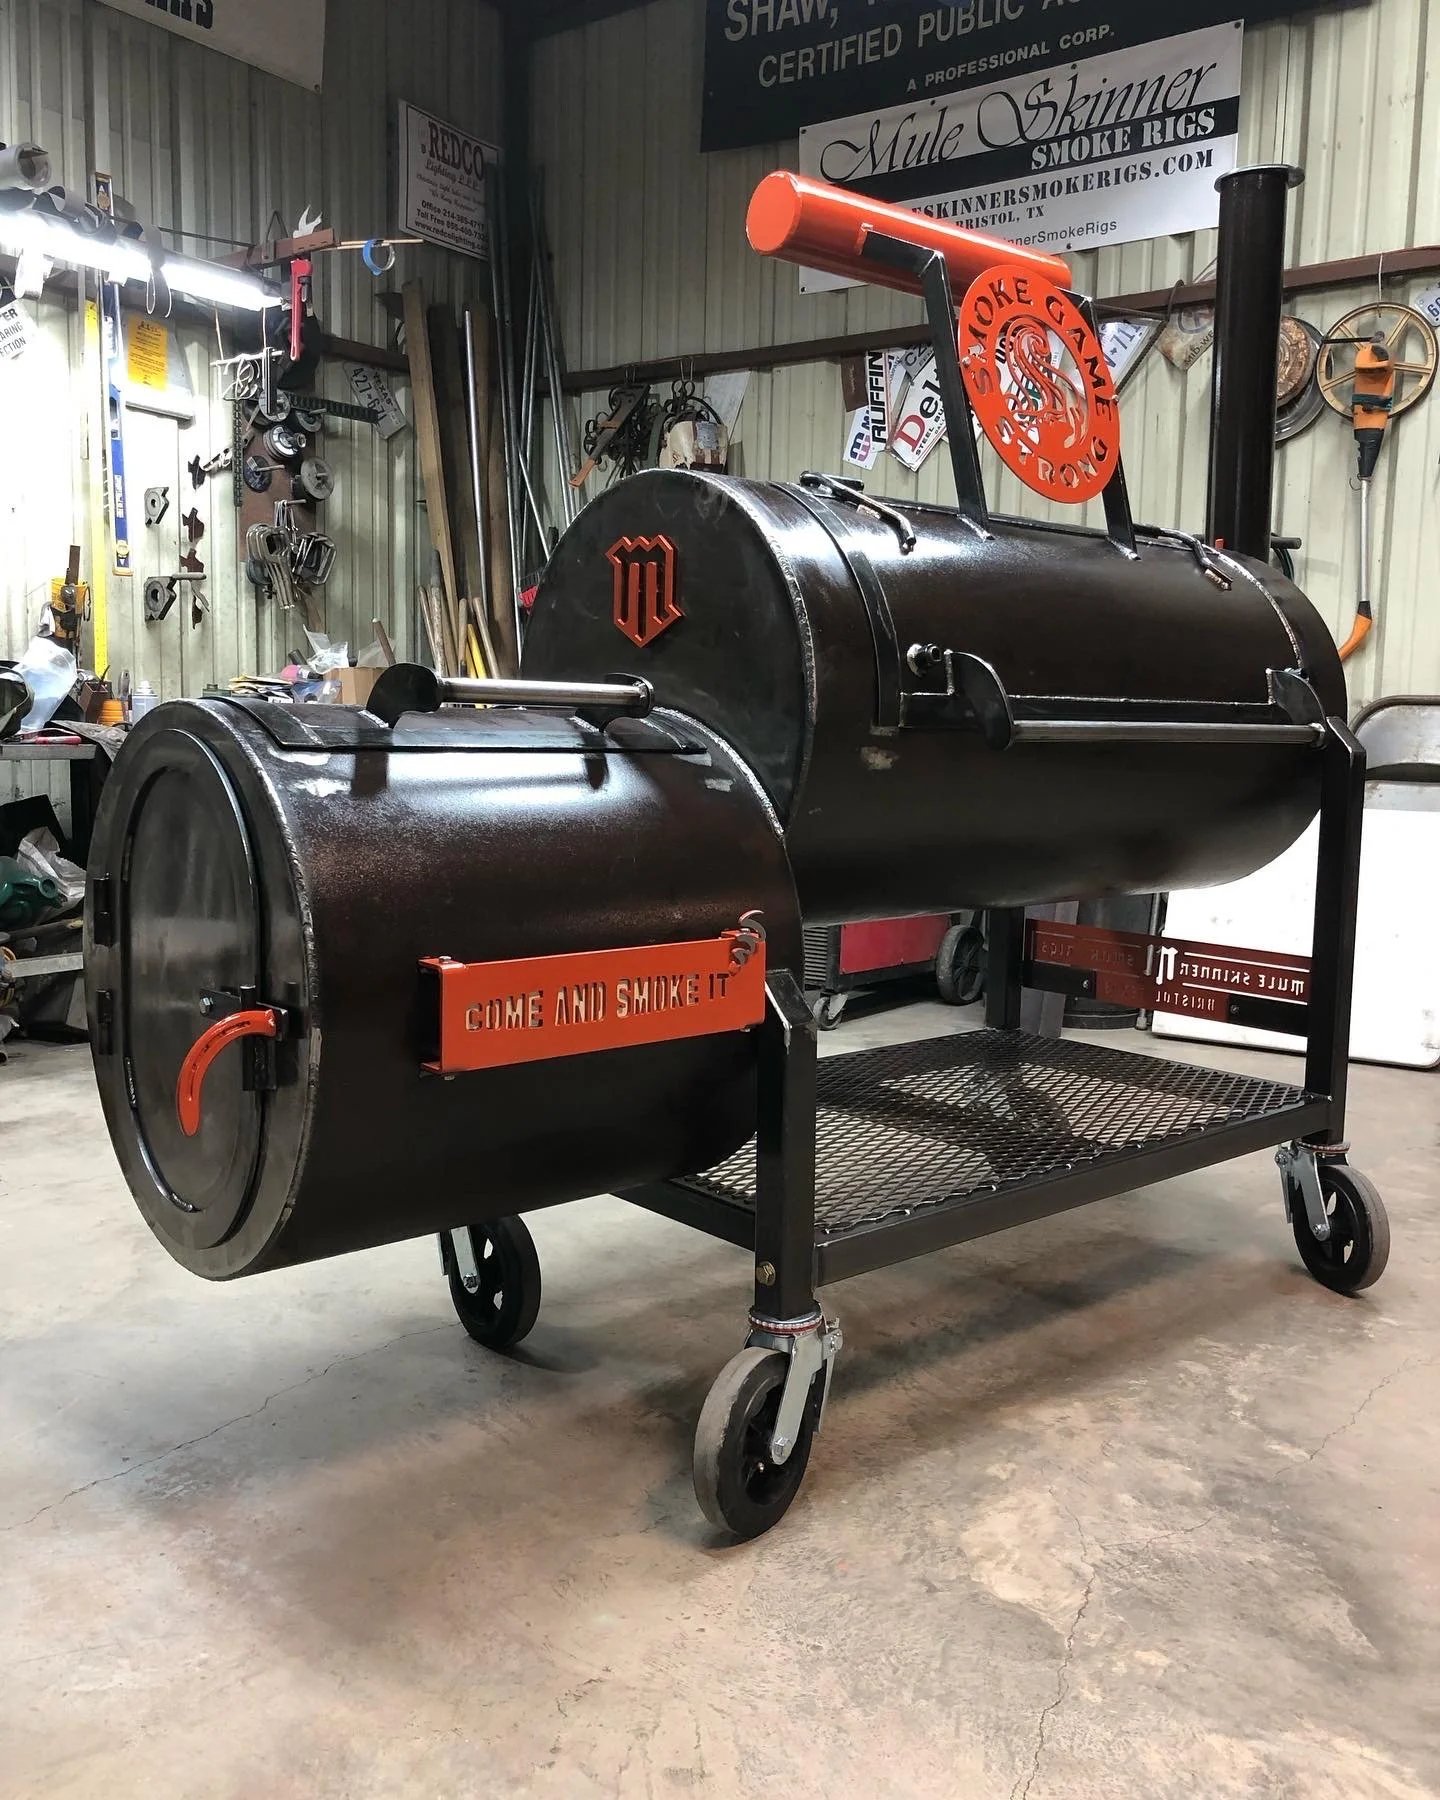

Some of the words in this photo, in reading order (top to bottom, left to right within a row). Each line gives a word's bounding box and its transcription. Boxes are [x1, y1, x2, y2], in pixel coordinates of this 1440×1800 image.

[724, 0, 838, 42] SHAW,
[758, 23, 902, 88] CERTIFIED
[917, 0, 1025, 48] PUBLIC
[906, 78, 918, 92] A
[925, 41, 1050, 87] PROFESSIONAL
[1058, 24, 1115, 50] CORP.
[428, 120, 485, 181] REDCO
[820, 105, 964, 183] Mule
[977, 62, 1217, 149] Skinner
[1031, 126, 1131, 170] SMOKE
[1142, 107, 1216, 147] RIGS
[421, 200, 442, 216] Office
[1003, 220, 1117, 247] nnerSmokeRigs
[1026, 204, 1045, 219] TX
[0, 308, 18, 321] ER
[968, 276, 1034, 396] SMOKE
[1045, 295, 1113, 422] GAME
[868, 351, 887, 444] RUFFIN
[915, 426, 935, 456] STEEL
[994, 415, 1108, 489] STRONG
[465, 989, 545, 1033] COME
[554, 981, 607, 1027] AND
[616, 973, 700, 1020] SMOKE
[708, 973, 730, 1000] IT
